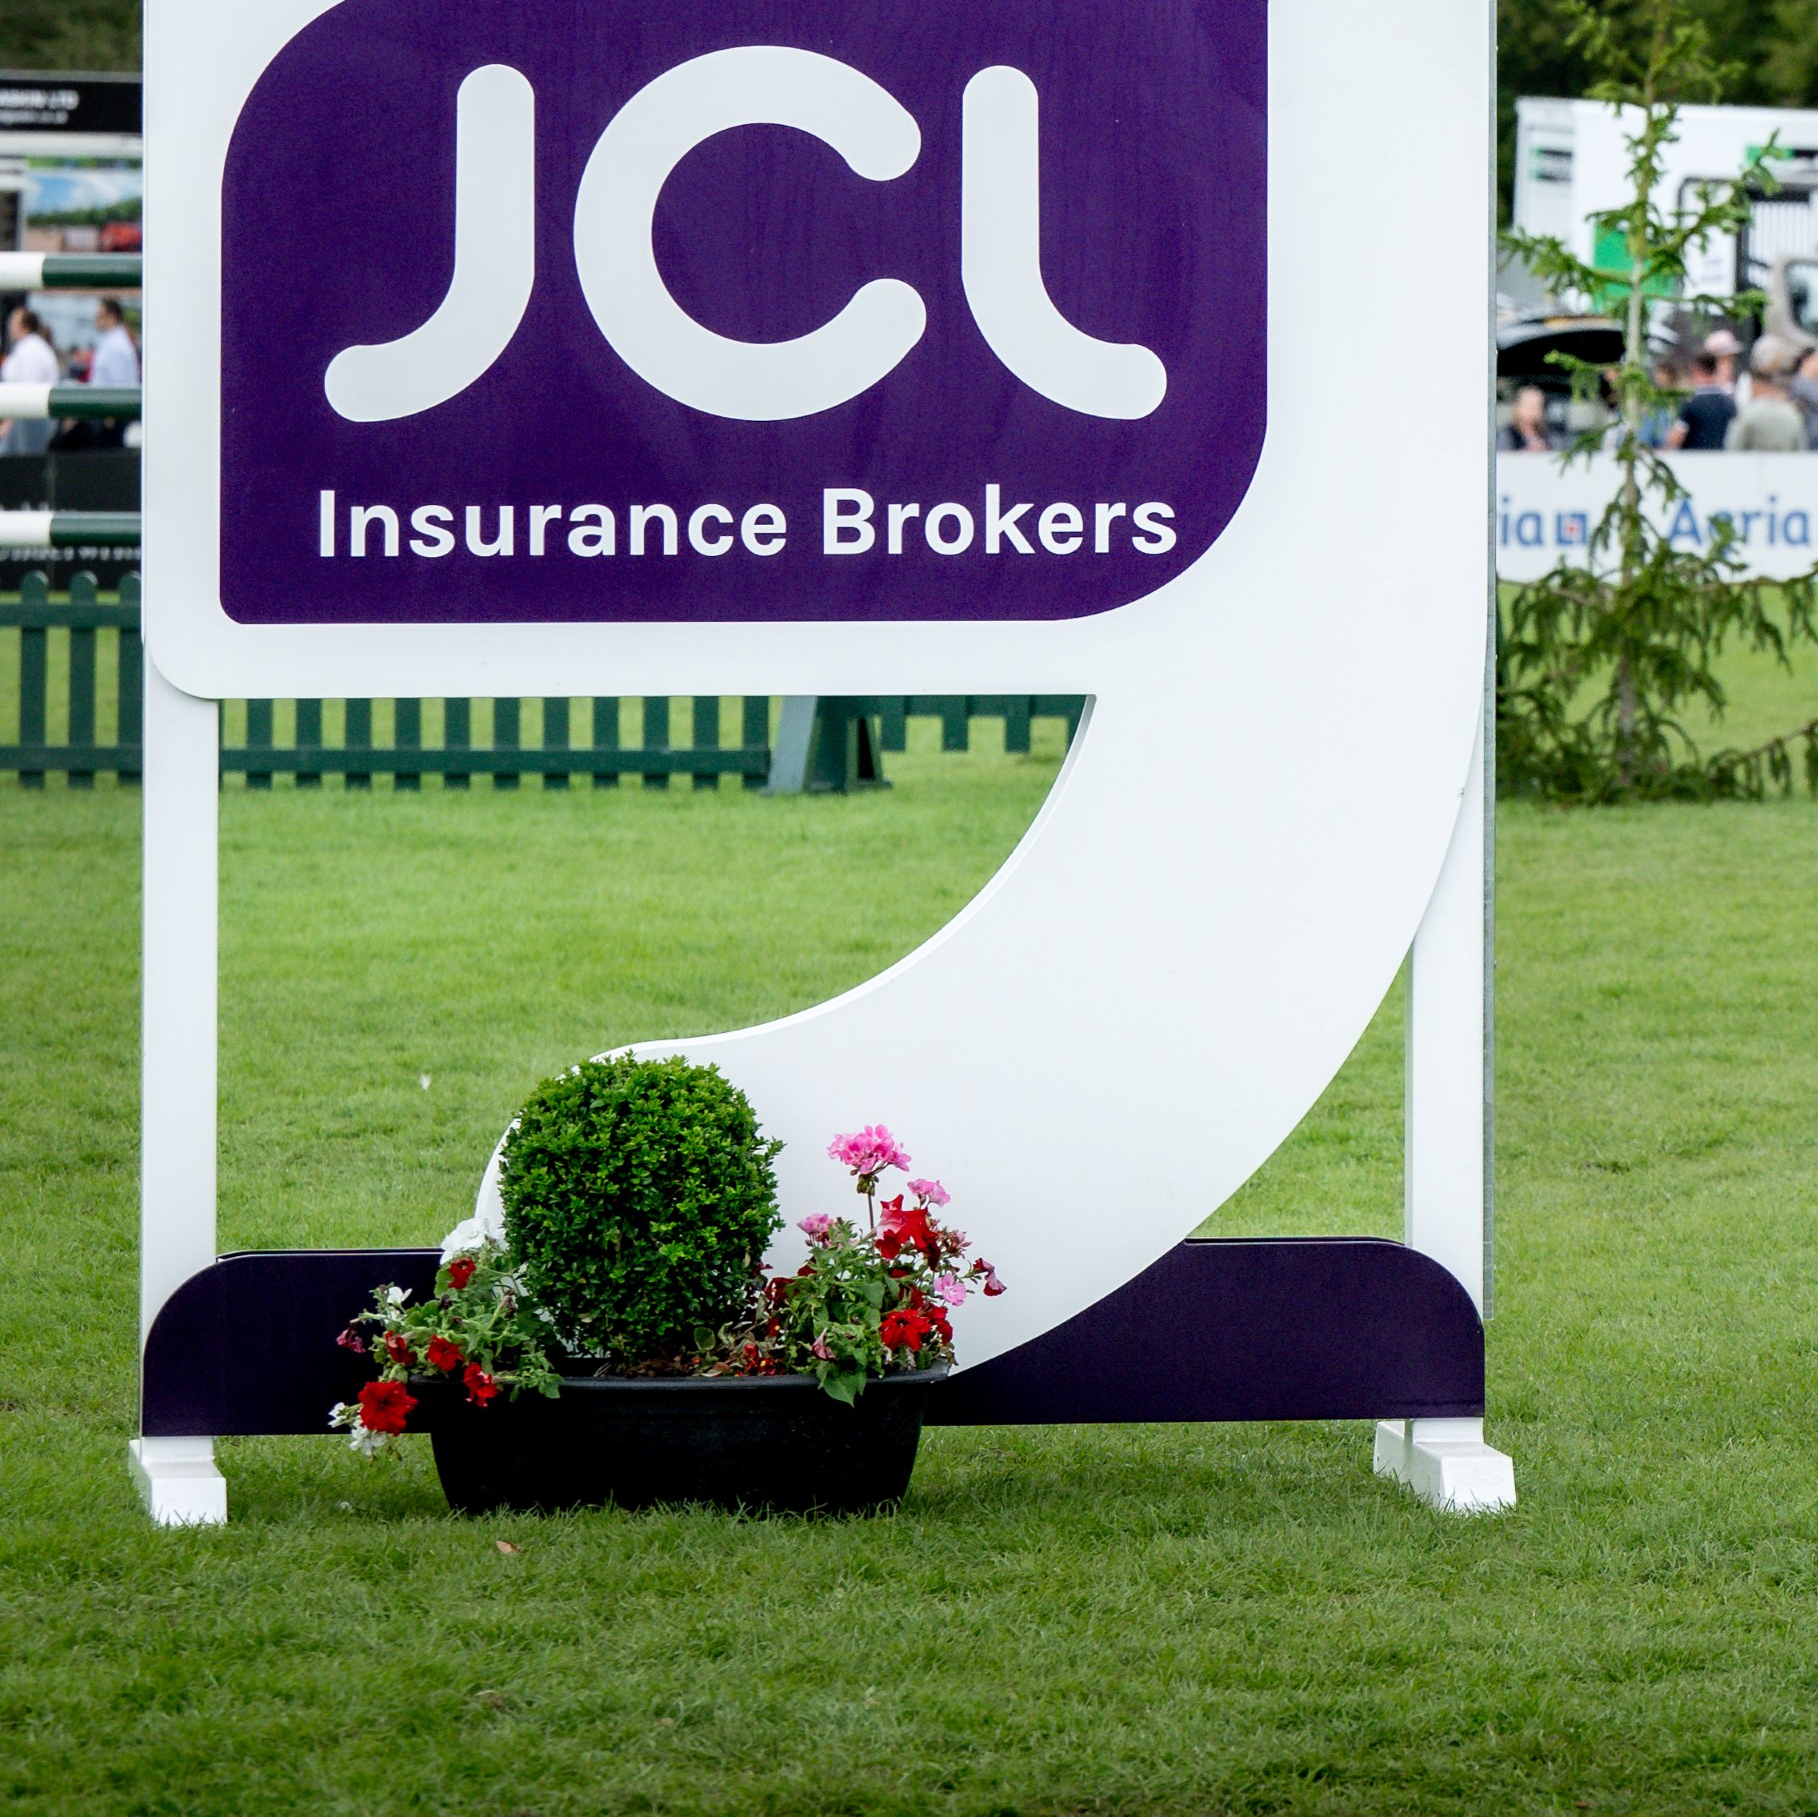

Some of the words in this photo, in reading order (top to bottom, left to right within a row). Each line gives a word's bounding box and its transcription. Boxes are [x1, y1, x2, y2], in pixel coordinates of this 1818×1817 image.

[325, 45, 1168, 423] JCL
[320, 489, 787, 558] Insurance
[823, 483, 1177, 557] Brokers
